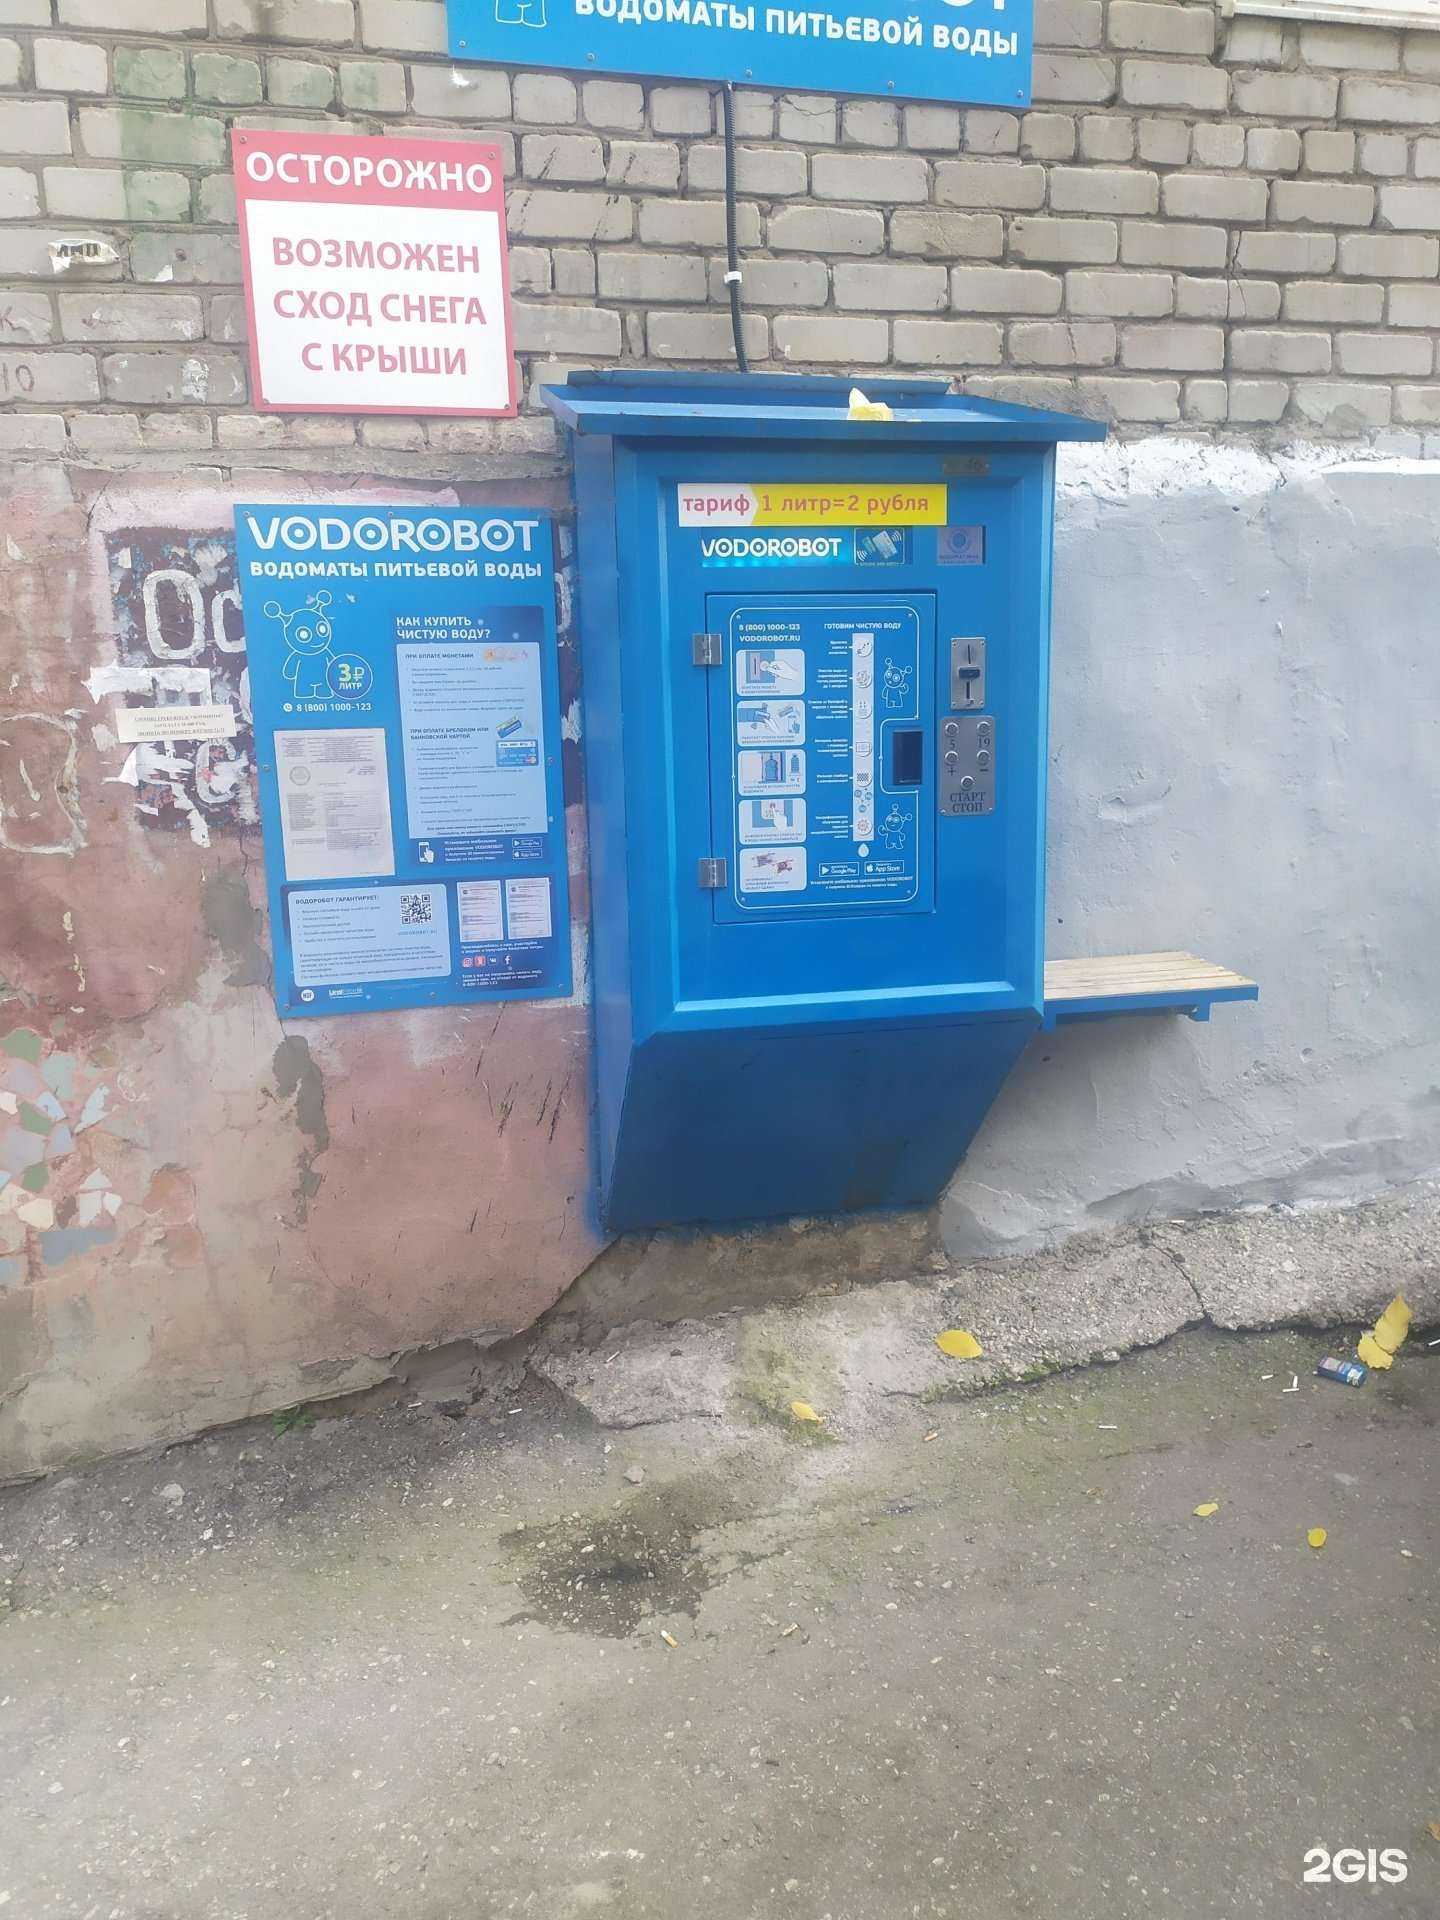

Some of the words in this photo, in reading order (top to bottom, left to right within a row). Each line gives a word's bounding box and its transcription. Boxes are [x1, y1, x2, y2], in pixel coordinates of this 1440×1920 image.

[576, 0, 754, 31] ВОДОМАТЫ
[765, 9, 922, 47] ПИТЬЕВОЙ
[932, 25, 1019, 57] ВОДЫ
[246, 151, 493, 193] ОСТОРОЖНО
[272, 237, 481, 273] ВОЗМОЖЕН
[273, 289, 373, 328] СХОД
[380, 293, 488, 325] СНЕГА
[301, 342, 324, 371] С
[332, 343, 468, 376] КРЫШИ
[682, 493, 750, 516] тариф
[762, 495, 773, 511] 1
[781, 494, 860, 516] литр=2
[867, 493, 929, 516] рубля
[247, 516, 539, 553] VODOROBOT
[701, 537, 843, 559] VODOROBOT
[250, 560, 368, 579] ВОДОМАТЫ
[374, 559, 478, 578] ПИТЬЕВОЙ
[484, 562, 543, 580] ВОДЫ
[396, 616, 421, 627] КАК
[424, 616, 472, 628] КУПИТЬ
[824, 622, 855, 630] ГОТОВИМ
[883, 622, 902, 630] ВОДУ
[396, 627, 449, 640] ЧИСТУЮ
[452, 627, 491, 640] ВОДУ?
[338, 680, 363, 692] ЛИТР
[296, 703, 303, 713] 8
[304, 702, 328, 714] (800)
[329, 702, 373, 713] 1000-123
[977, 738, 991, 748] 19
[950, 791, 986, 803] СТАРТ
[952, 802, 983, 814] СТОП
